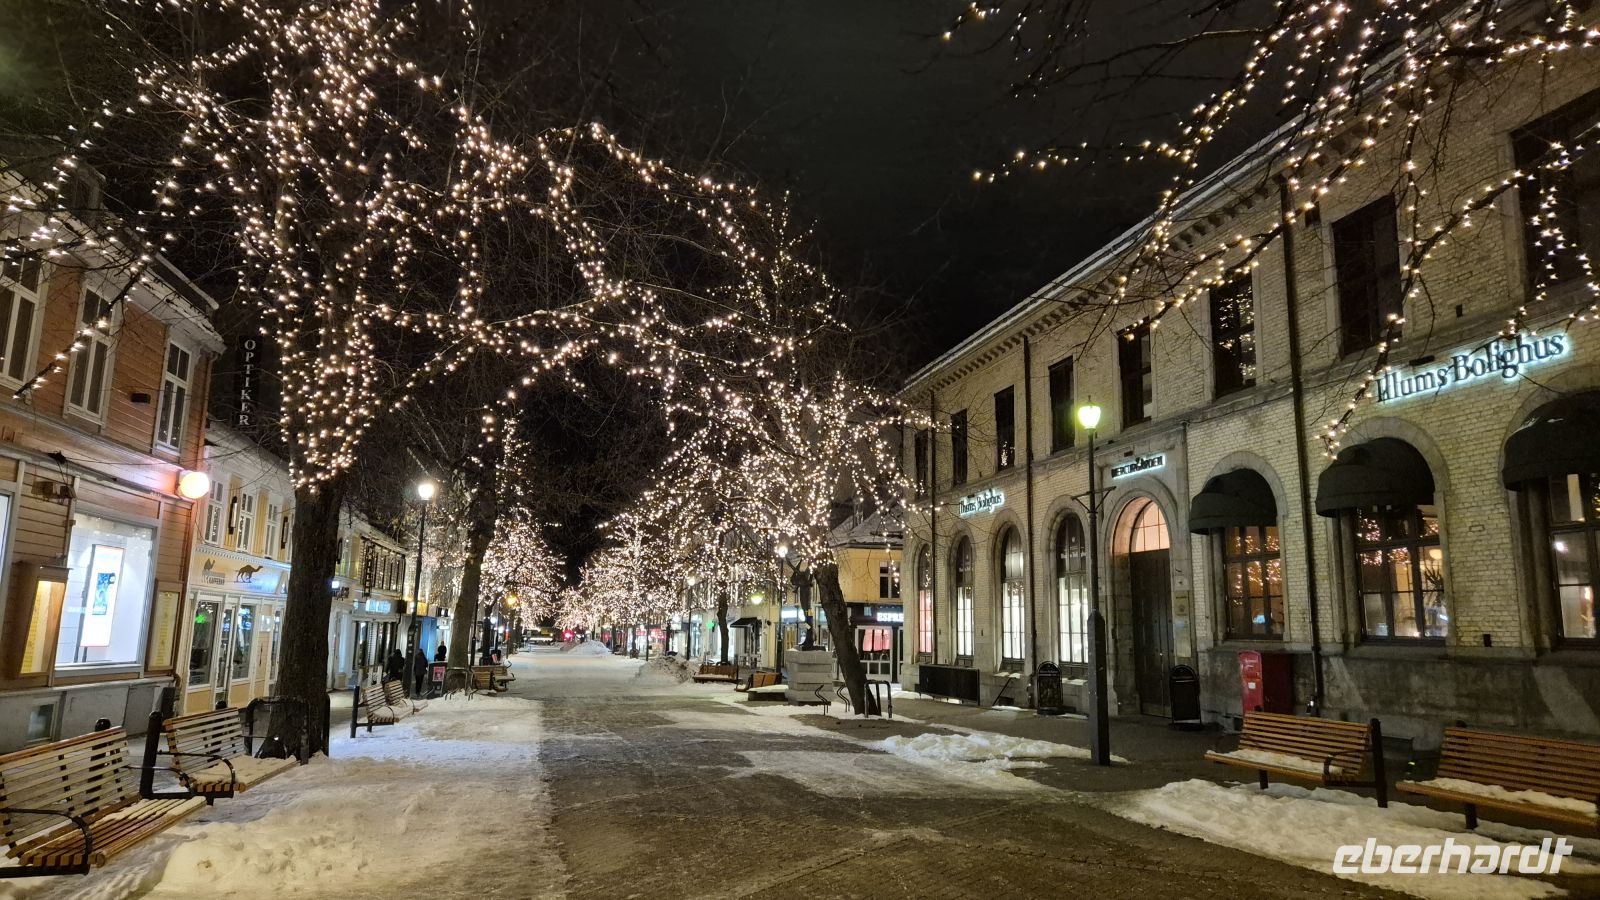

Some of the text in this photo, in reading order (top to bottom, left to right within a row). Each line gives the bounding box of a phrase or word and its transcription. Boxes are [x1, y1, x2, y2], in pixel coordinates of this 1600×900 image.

[239, 339, 256, 426] OPTIKER
[1376, 334, 1565, 403] Illums Bolighus
